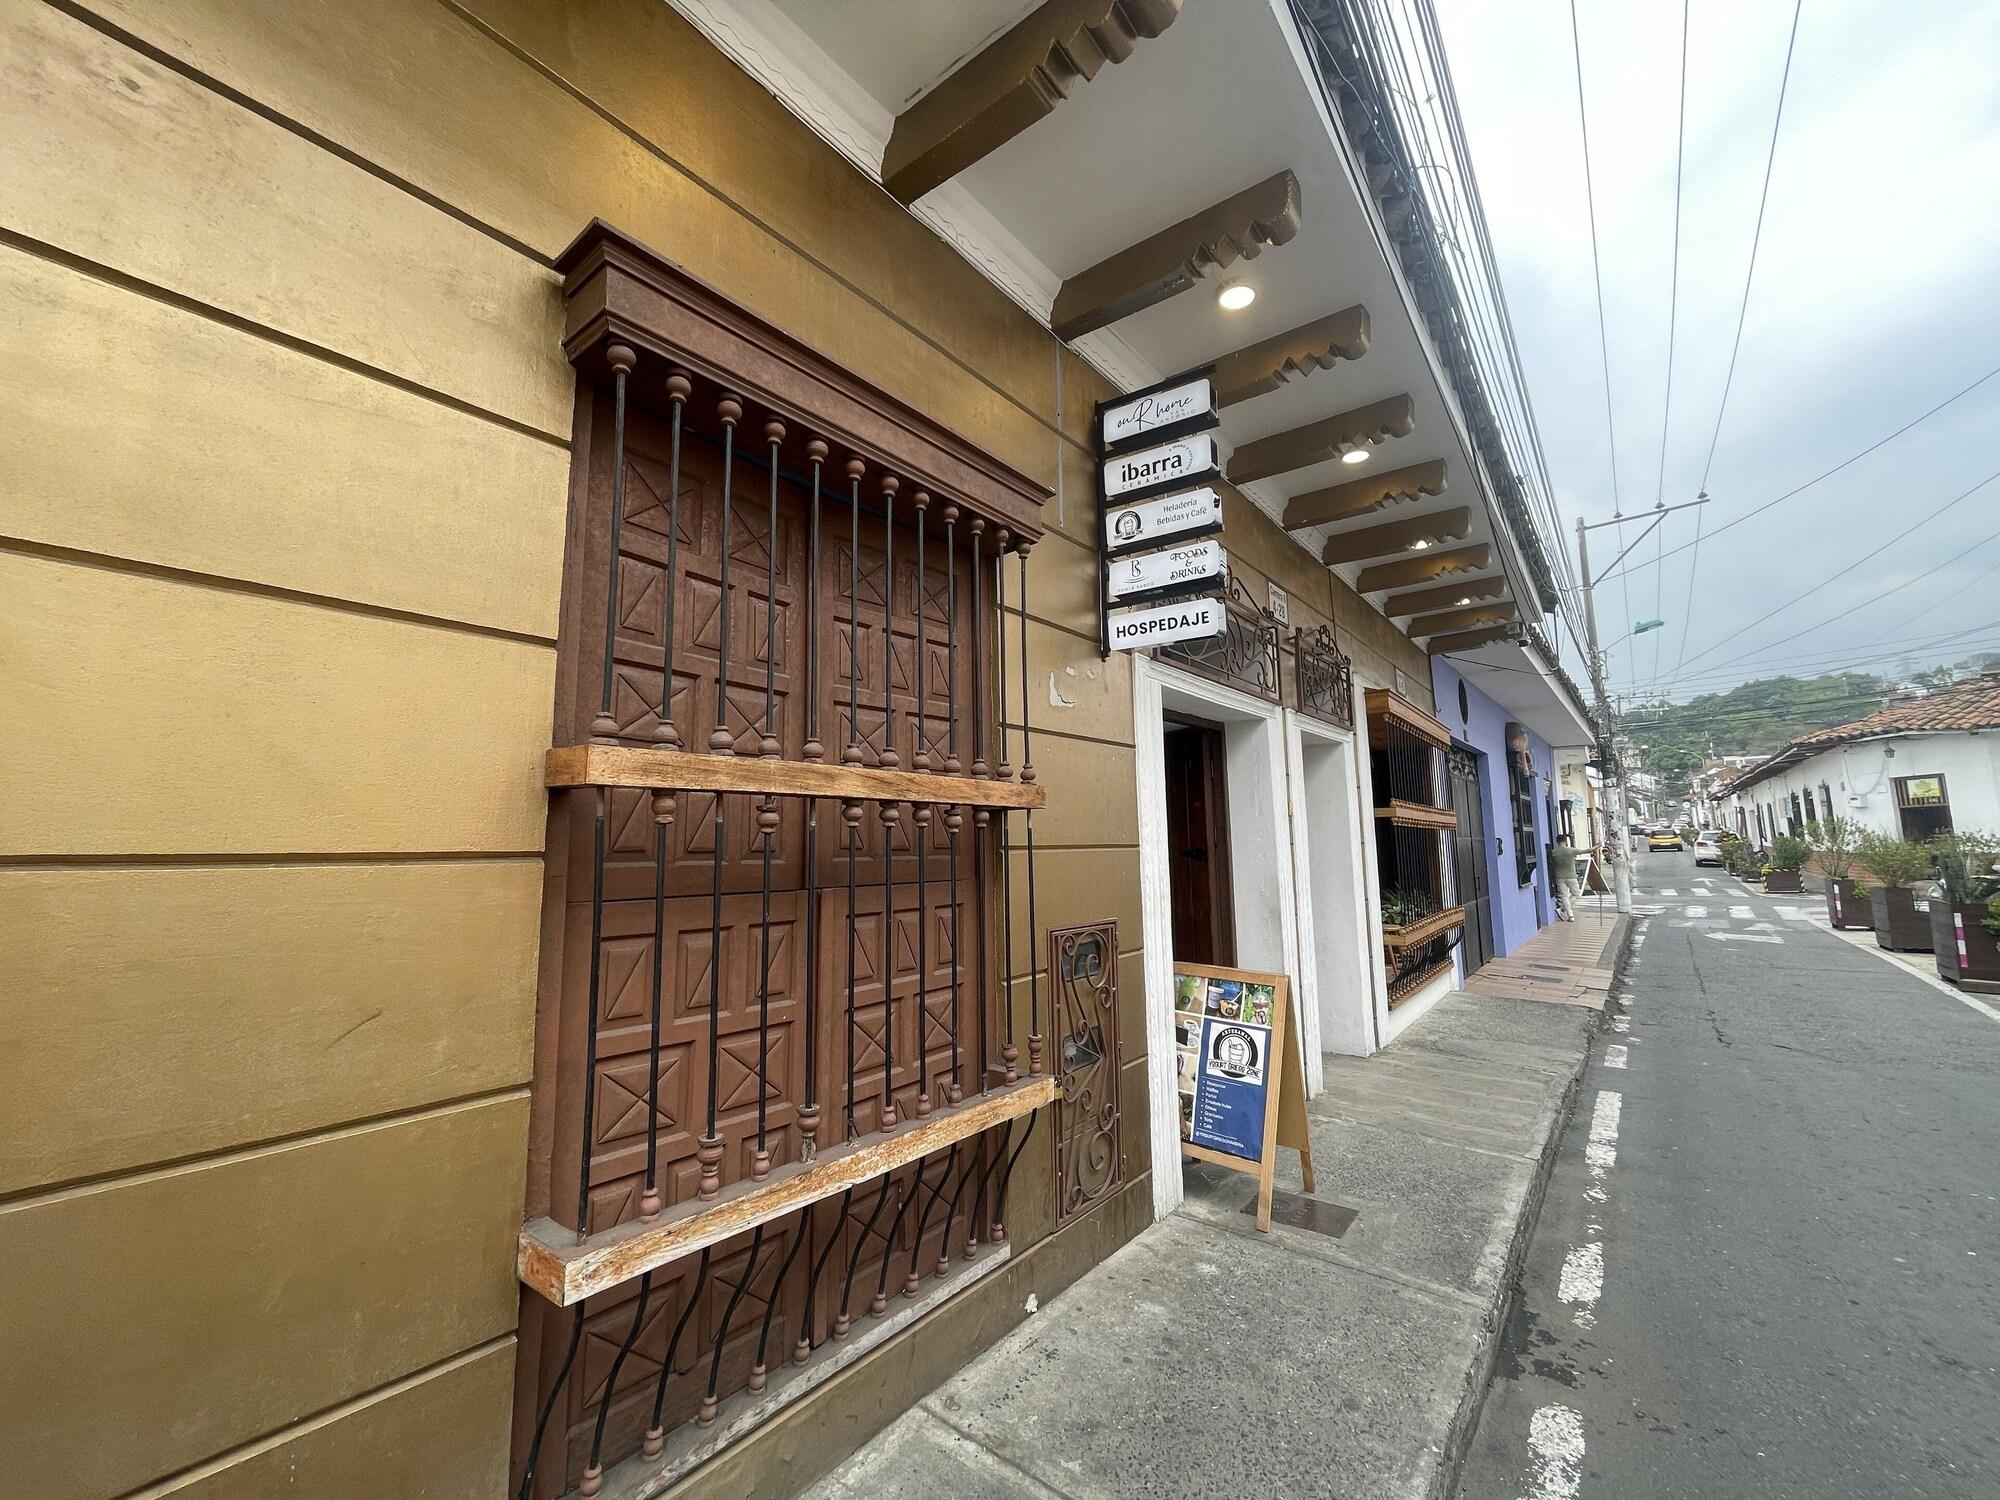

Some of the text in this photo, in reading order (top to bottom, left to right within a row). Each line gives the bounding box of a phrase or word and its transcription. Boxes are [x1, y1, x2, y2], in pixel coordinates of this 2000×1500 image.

[1121, 454, 1182, 482] ibarra
[1156, 512, 1185, 526] Bebidas
[1190, 505, 1207, 518] Café
[1169, 546, 1208, 562] FOODS
[1185, 558, 1192, 567] &
[1169, 564, 1207, 581] DRINKS
[1116, 611, 1210, 639] HOSPEDAJE
